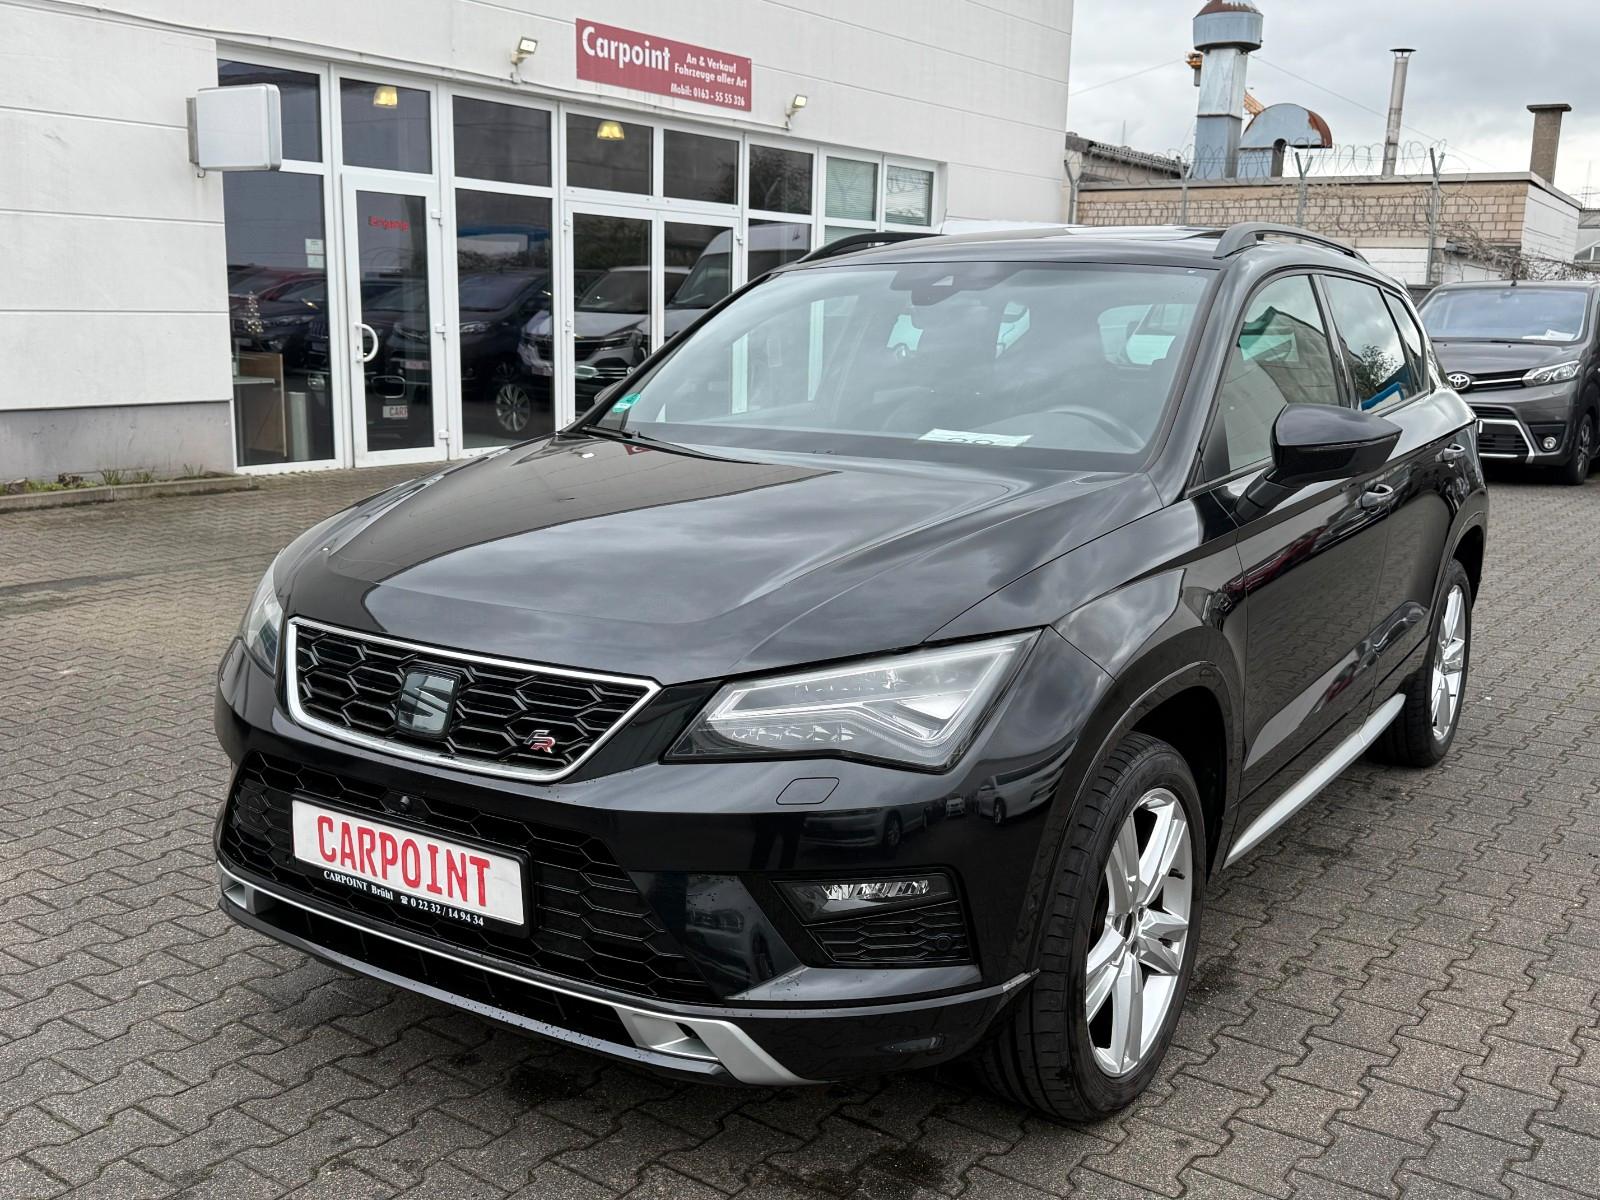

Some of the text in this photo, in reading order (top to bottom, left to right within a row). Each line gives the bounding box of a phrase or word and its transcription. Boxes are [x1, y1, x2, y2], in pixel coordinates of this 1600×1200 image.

[582, 26, 670, 72] Carpoint
[674, 62, 747, 88] Fahrzeuge aller Art
[686, 53, 737, 74] An & Verkauf
[671, 82, 692, 97] Mobil:
[523, 729, 556, 753] FR
[317, 815, 490, 907] CARPOINT
[323, 870, 368, 891] CARPOINT
[371, 884, 394, 901] Brühl
[410, 897, 416, 907] 0
[418, 899, 429, 911] 22
[430, 903, 441, 914] 32
[448, 908, 458, 919] 14
[460, 911, 471, 922] 94
[473, 915, 484, 926] 34
